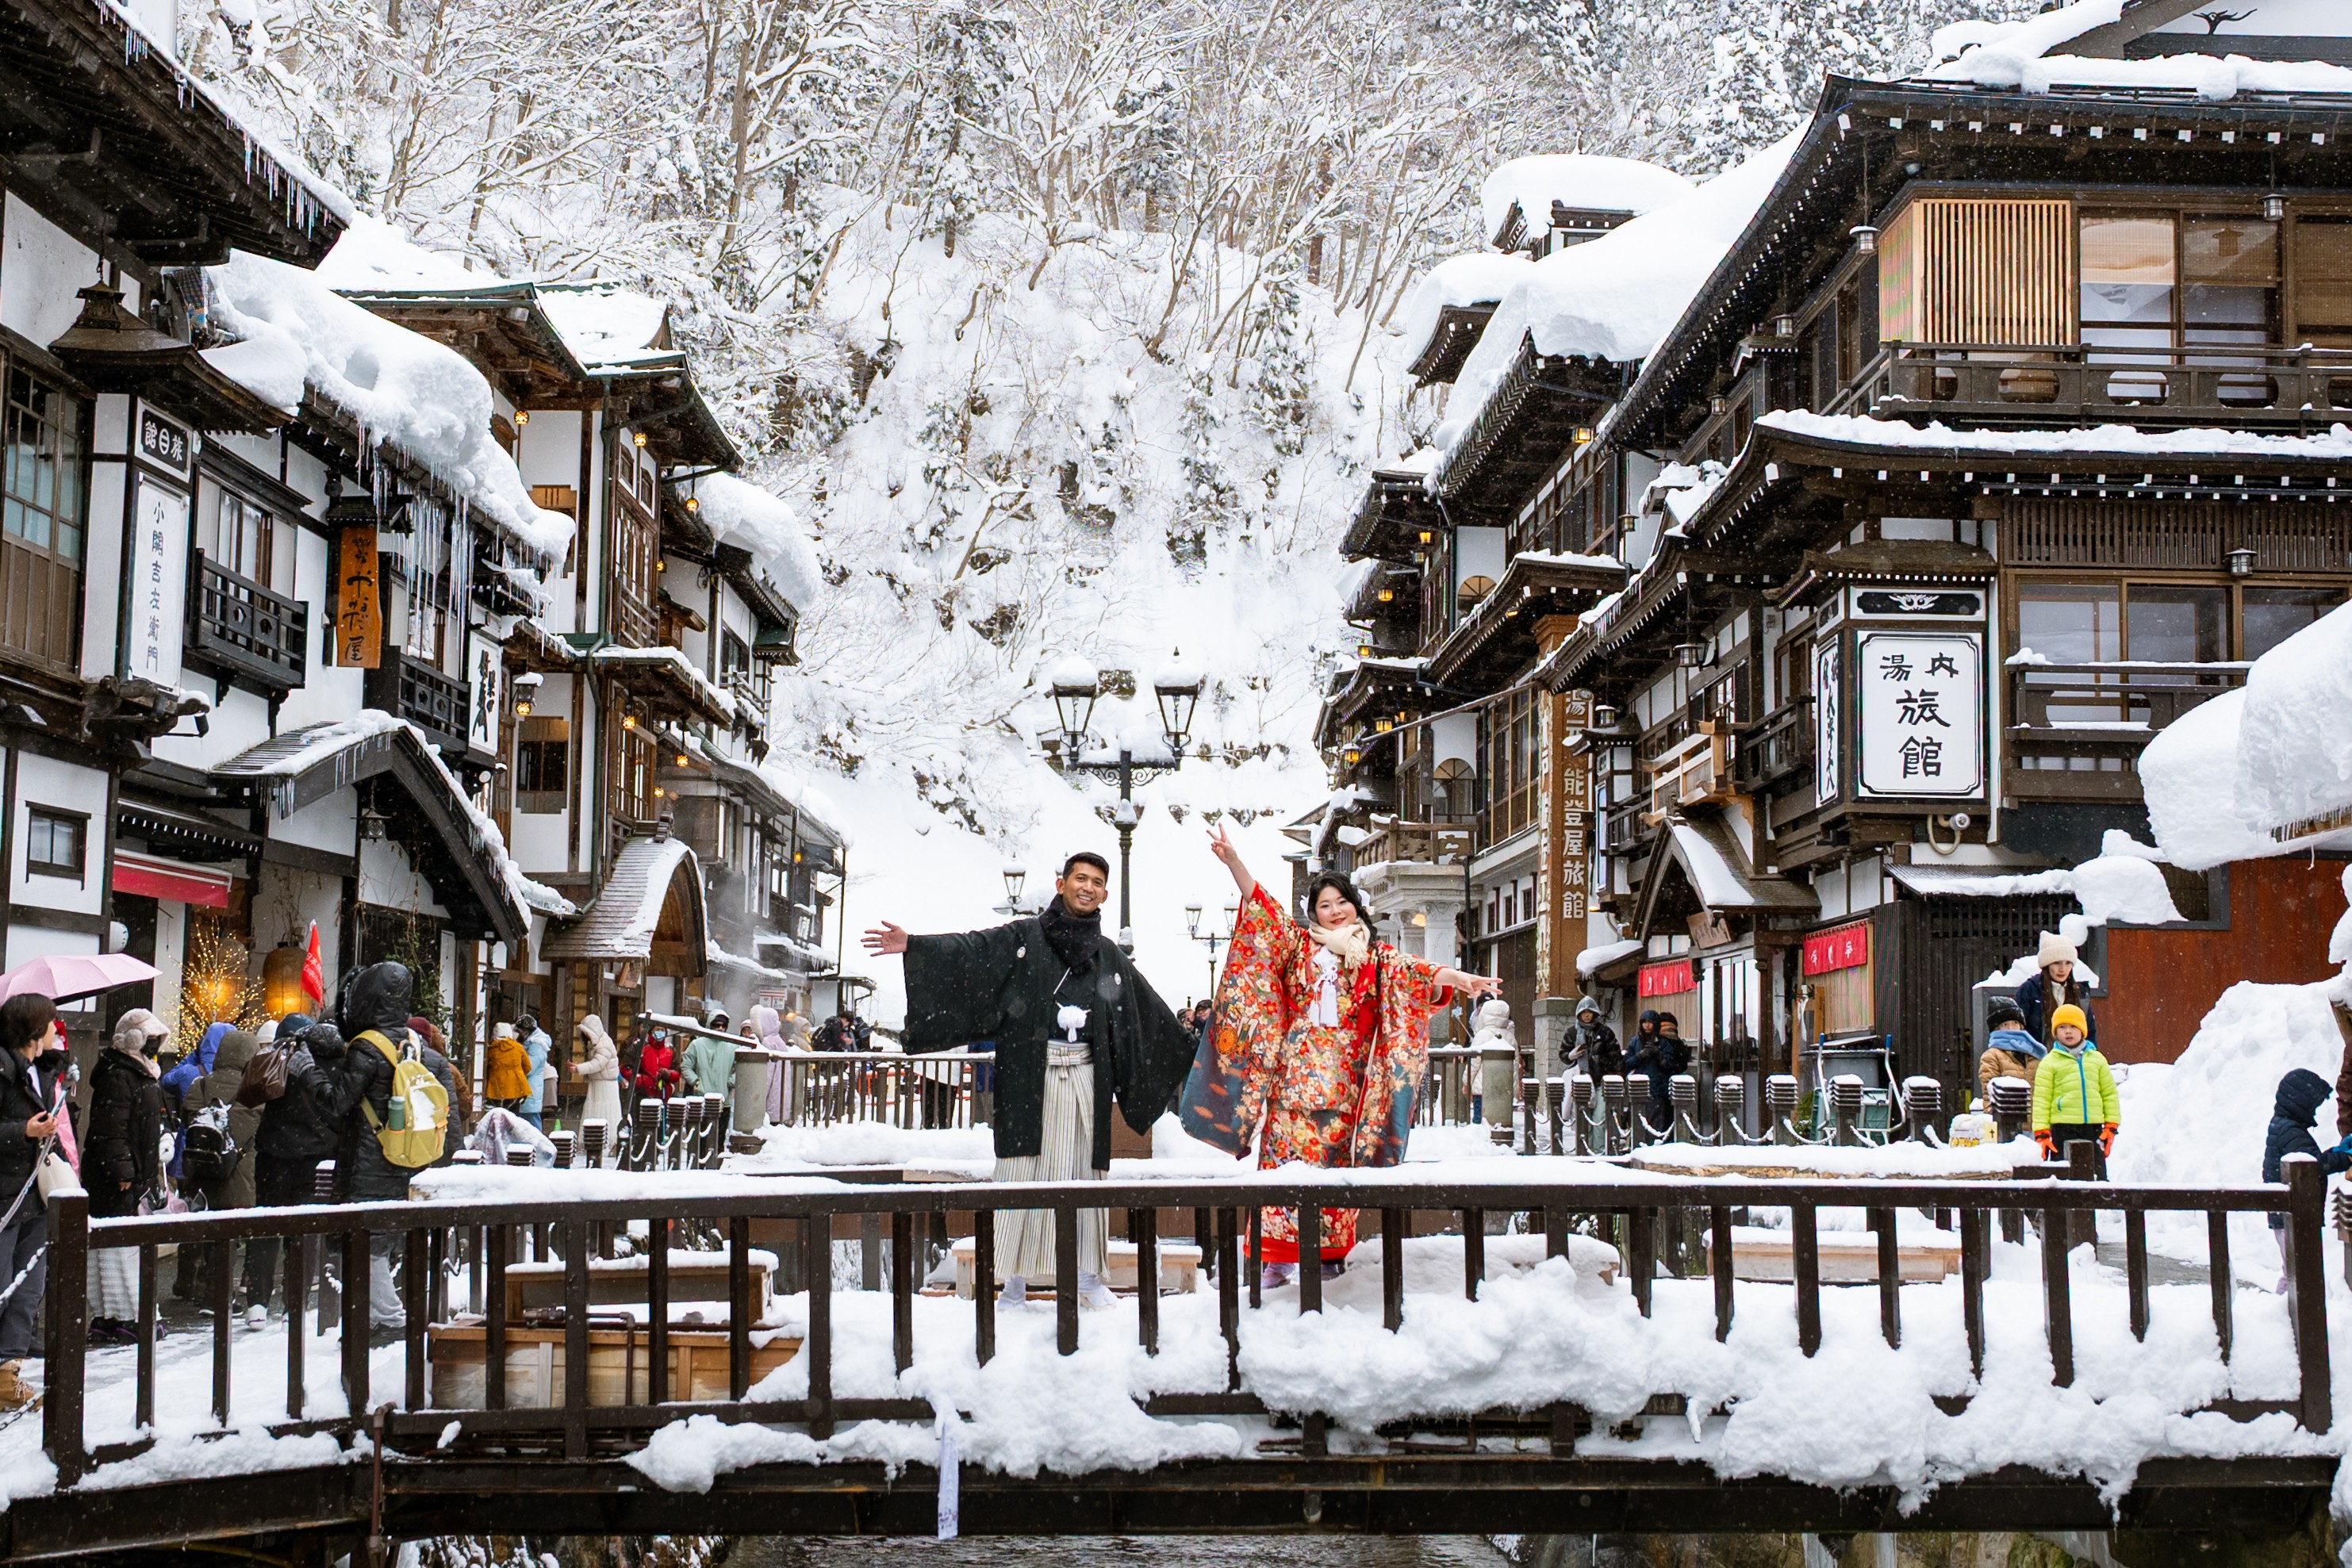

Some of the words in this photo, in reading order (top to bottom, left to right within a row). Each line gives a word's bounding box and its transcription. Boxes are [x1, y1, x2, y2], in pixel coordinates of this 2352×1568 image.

[1895, 688, 1951, 779] 旅館
[1562, 768, 1585, 919] 能登屋旅館
